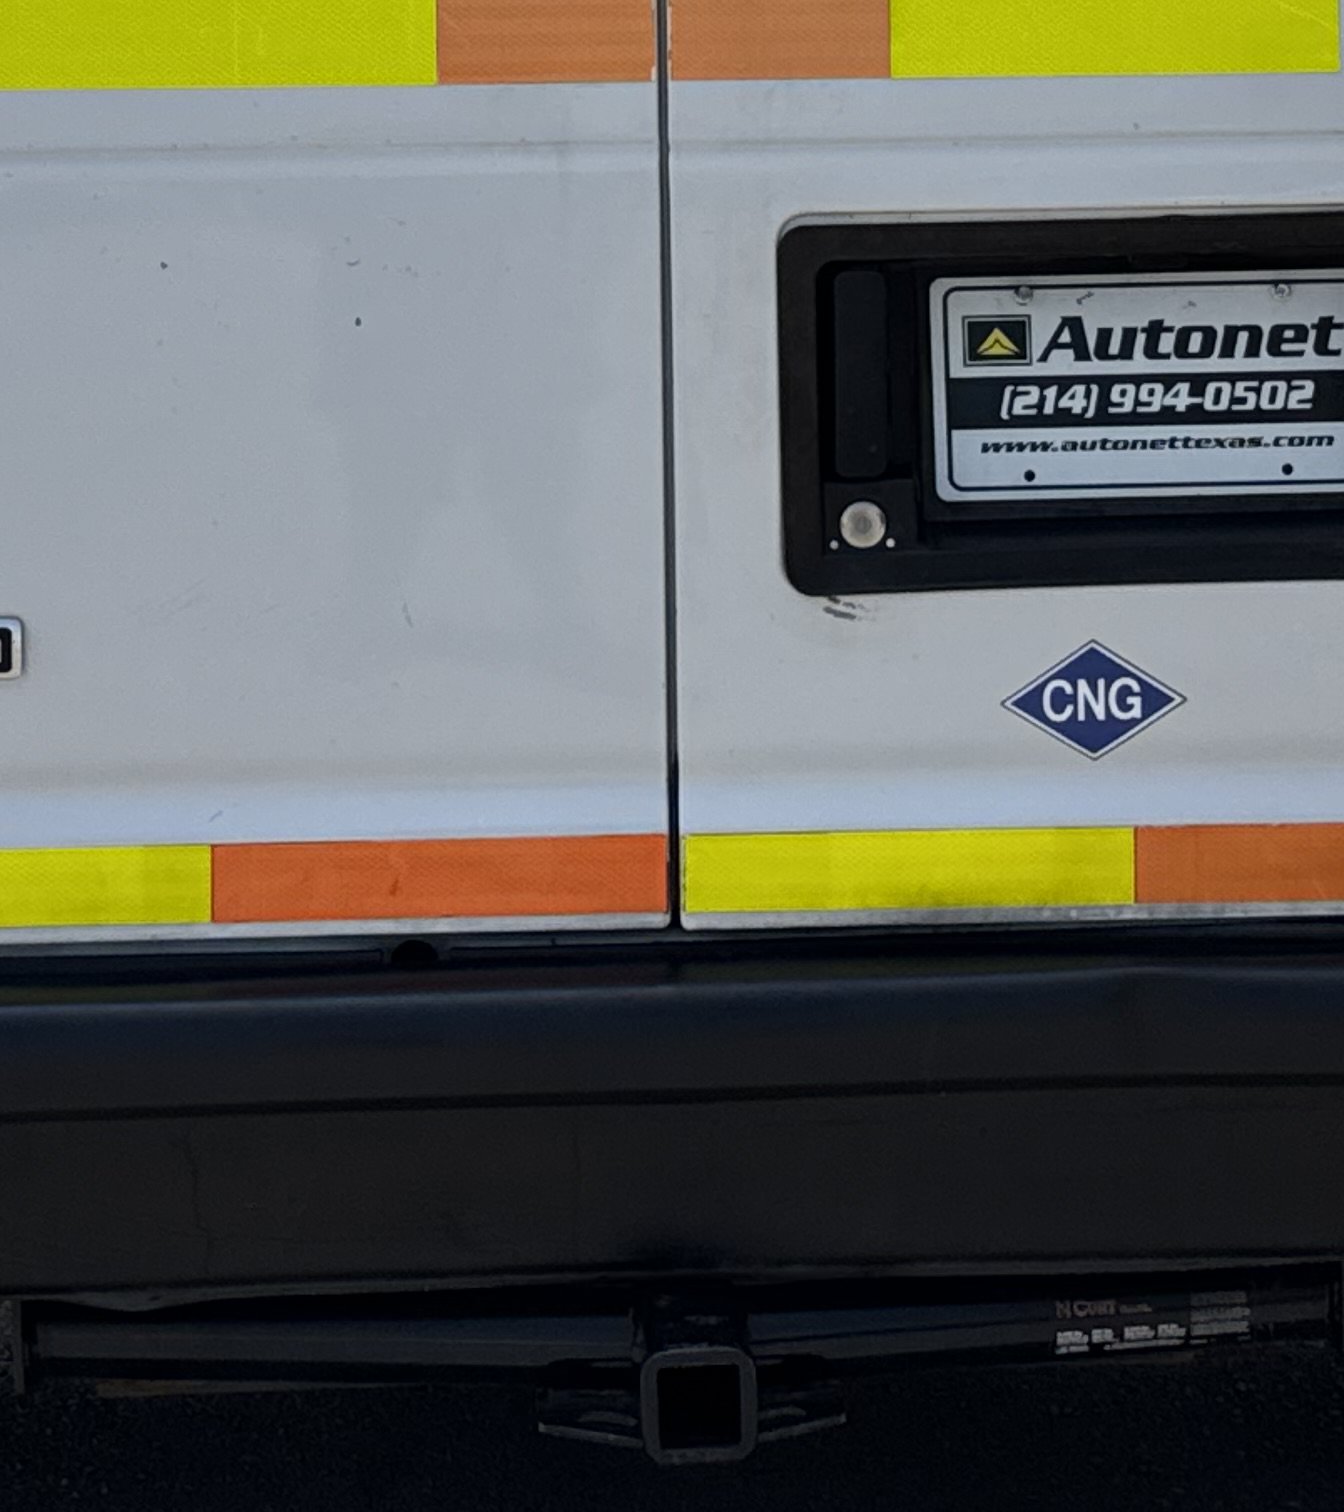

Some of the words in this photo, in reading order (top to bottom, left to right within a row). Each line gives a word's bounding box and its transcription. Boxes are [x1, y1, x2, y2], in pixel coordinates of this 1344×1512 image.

[1036, 315, 1344, 363] Autonet
[999, 383, 1098, 420] (214)
[1107, 379, 1315, 414] 994-0502
[980, 434, 1335, 455] www.autonettexas.com
[1041, 676, 1144, 723] CNG
